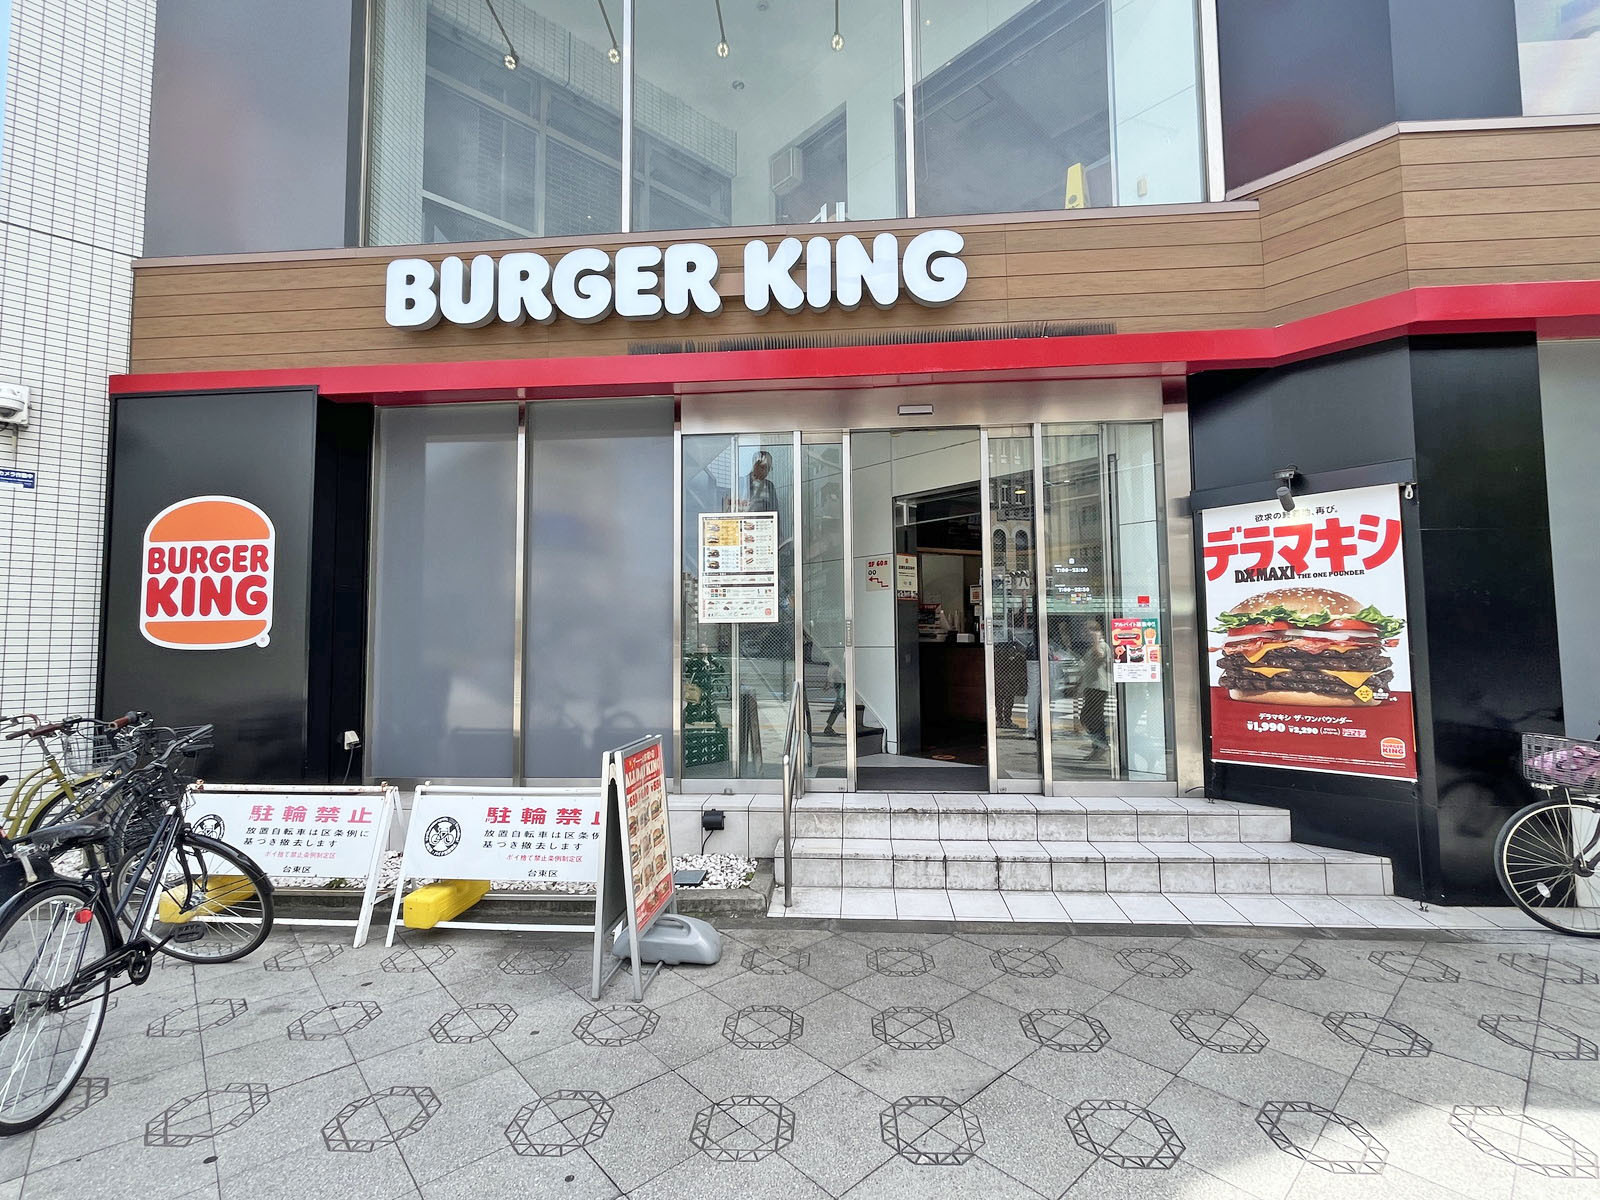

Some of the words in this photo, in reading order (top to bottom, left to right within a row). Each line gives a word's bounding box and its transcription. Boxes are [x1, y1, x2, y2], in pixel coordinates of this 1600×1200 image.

[385, 242, 722, 330] BURGER
[743, 229, 968, 312] KING
[1203, 514, 1402, 582] デラマキシ
[148, 544, 269, 575] BURGER
[1328, 569, 1365, 577] POUNDER
[145, 574, 268, 617] KING
[1259, 712, 1291, 721] デラマキシ
[1247, 720, 1286, 733] ¥1,990
[249, 805, 374, 824] 駐輪禁止
[245, 827, 369, 838] 放置自転車は区条例に
[243, 837, 338, 848] 基つき撤去します
[482, 841, 583, 850] 基つき撤去します
[506, 854, 583, 863] ポイ捨て禁止条例制定区
[282, 865, 312, 874] 台東区
[527, 869, 558, 878] 台東区
